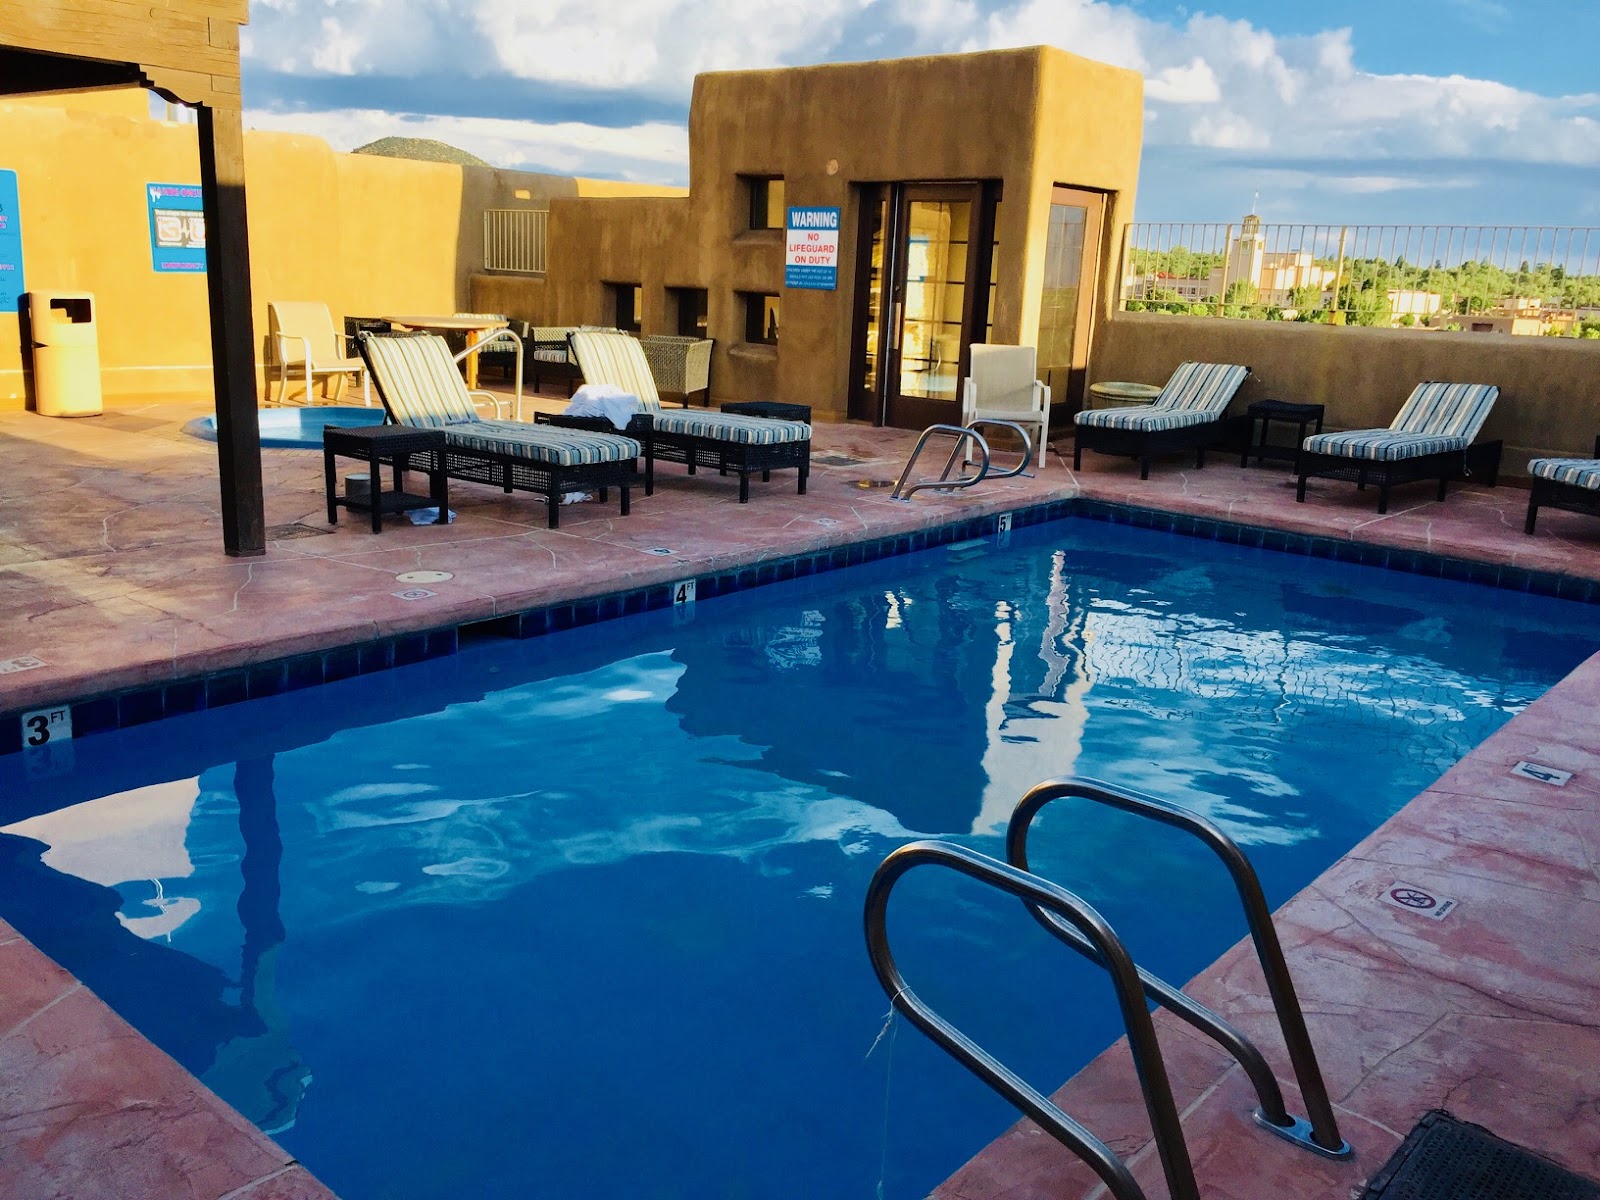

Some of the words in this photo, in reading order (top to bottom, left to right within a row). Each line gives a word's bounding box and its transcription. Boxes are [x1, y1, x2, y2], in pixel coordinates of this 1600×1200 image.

[791, 211, 838, 228] WARNING
[807, 232, 820, 241] NO
[789, 243, 835, 253] LIFEGUARD
[794, 255, 807, 264] ON
[808, 256, 831, 265] DUTY
[999, 516, 1007, 532] 5
[676, 583, 688, 603] 4
[687, 581, 695, 590] FT
[27, 715, 50, 746] 3
[50, 710, 65, 723] FT
[1522, 768, 1561, 781] 4
